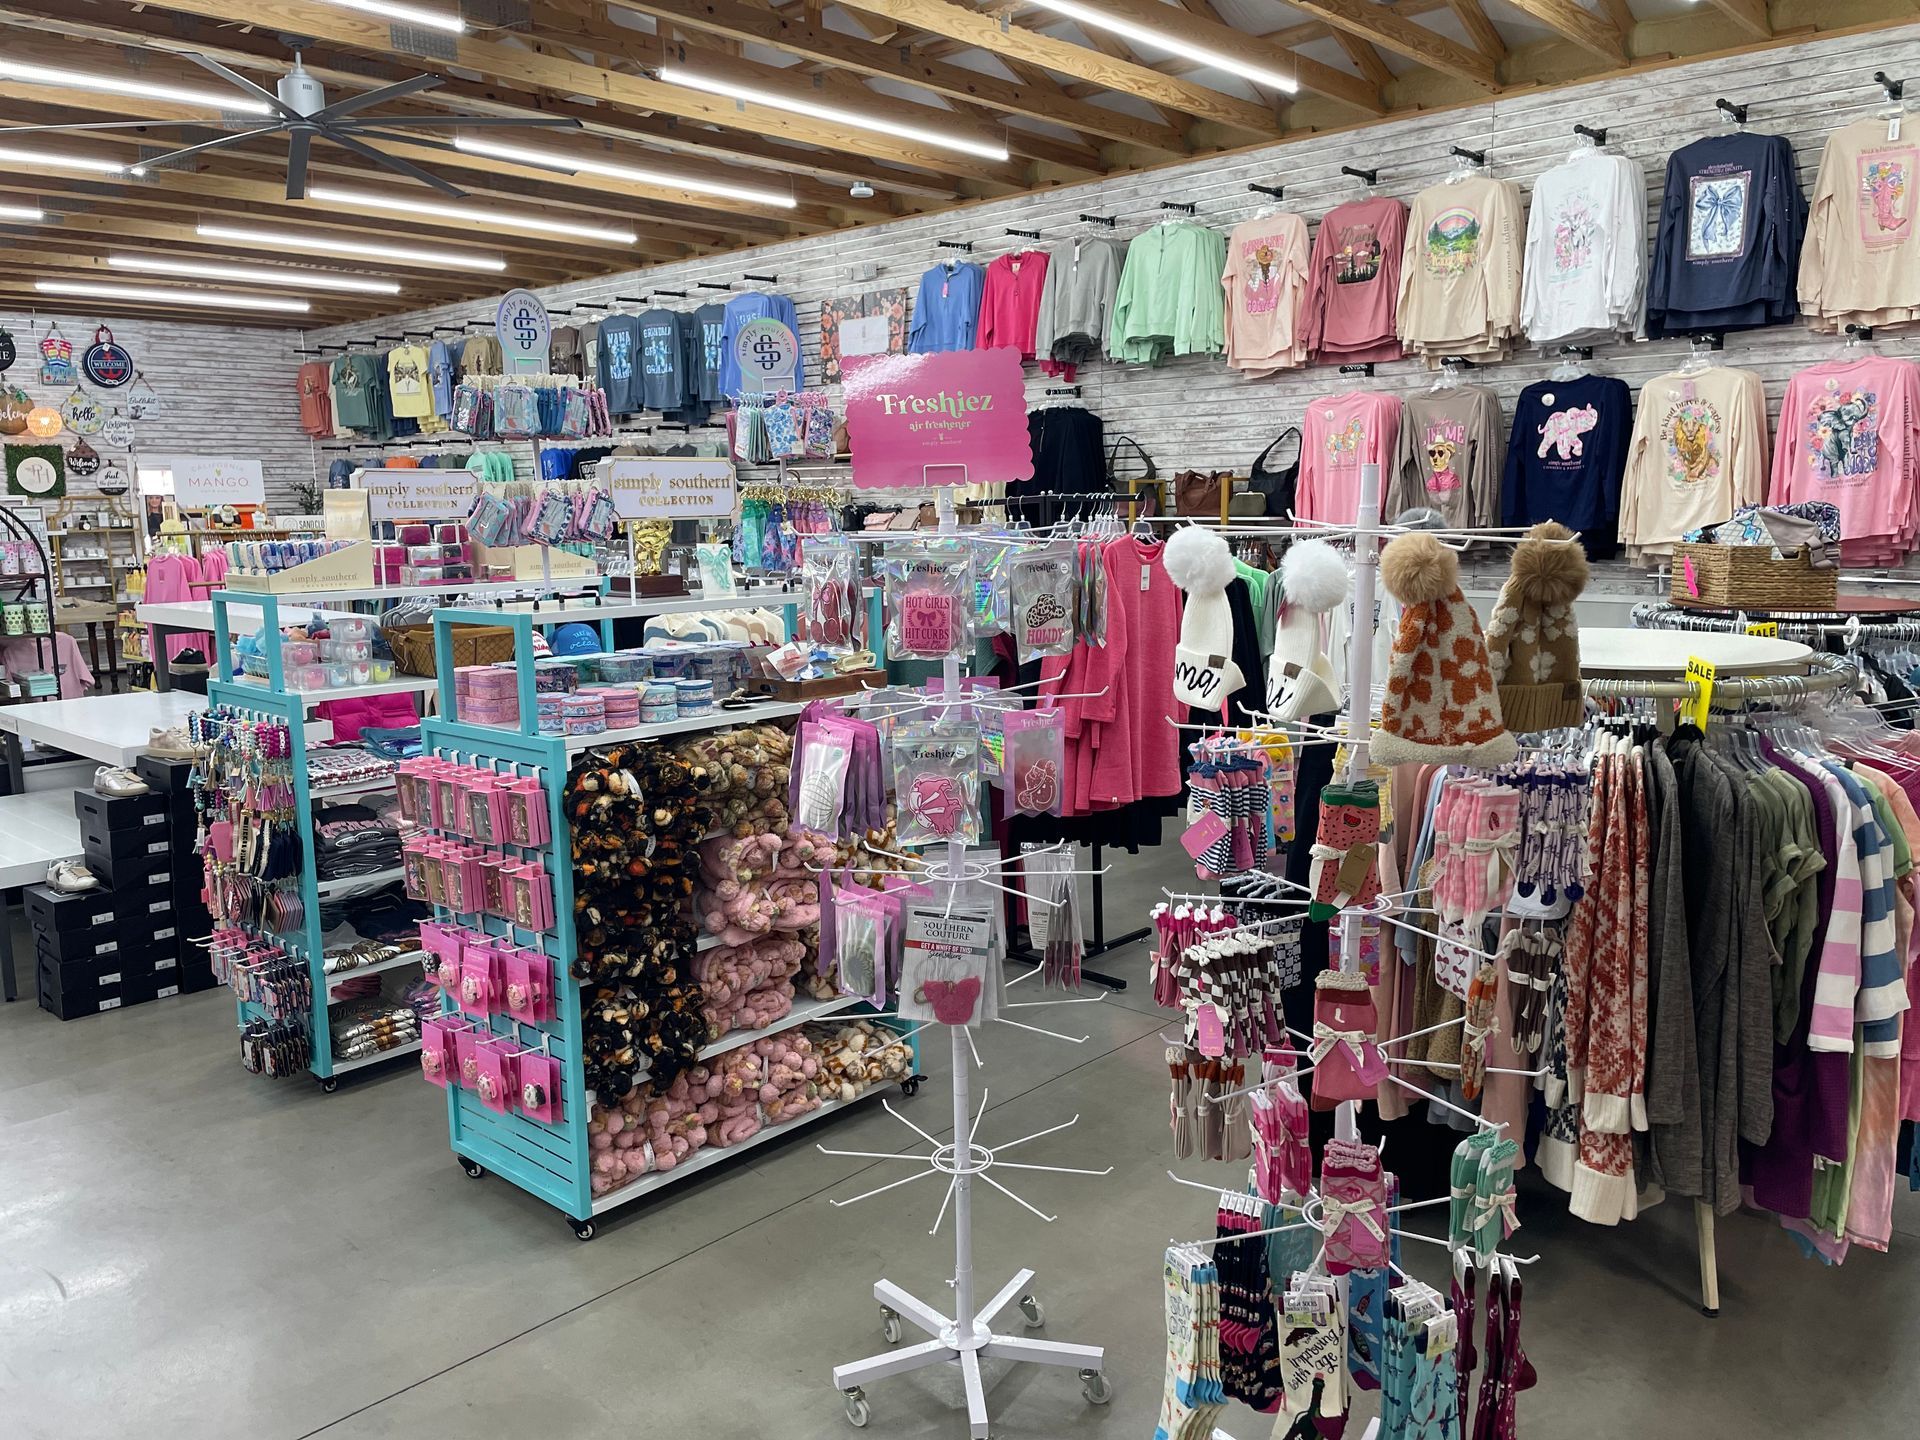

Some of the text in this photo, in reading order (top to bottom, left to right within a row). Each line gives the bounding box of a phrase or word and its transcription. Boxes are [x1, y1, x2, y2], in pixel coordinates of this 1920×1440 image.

[503, 301, 517, 332] simply
[742, 329, 757, 356] simply
[876, 390, 994, 418] Freshiez
[72, 406, 96, 421] hello
[909, 420, 972, 431] air freshener
[1444, 425, 1465, 444] ME
[188, 477, 249, 488] MANGO
[614, 472, 663, 494] simply
[669, 472, 731, 489] southern
[370, 482, 409, 499] imply
[387, 500, 458, 509] COLLECTION
[639, 495, 714, 506] COLLECTION
[1027, 562, 1058, 573] Freshiez
[905, 597, 950, 609] HOT GIRLS
[905, 628, 949, 640] HIT CURBS
[1027, 628, 1064, 645] HOWDY
[1687, 660, 1712, 681] SALE
[912, 749, 955, 761] Freshiez
[923, 921, 974, 933] SOUTHERN
[925, 929, 971, 940] COUTURE
[920, 942, 931, 950] GET
[935, 943, 951, 951] WHIFF
[1286, 1328, 1340, 1369] improving
[1287, 1352, 1338, 1391] with age
